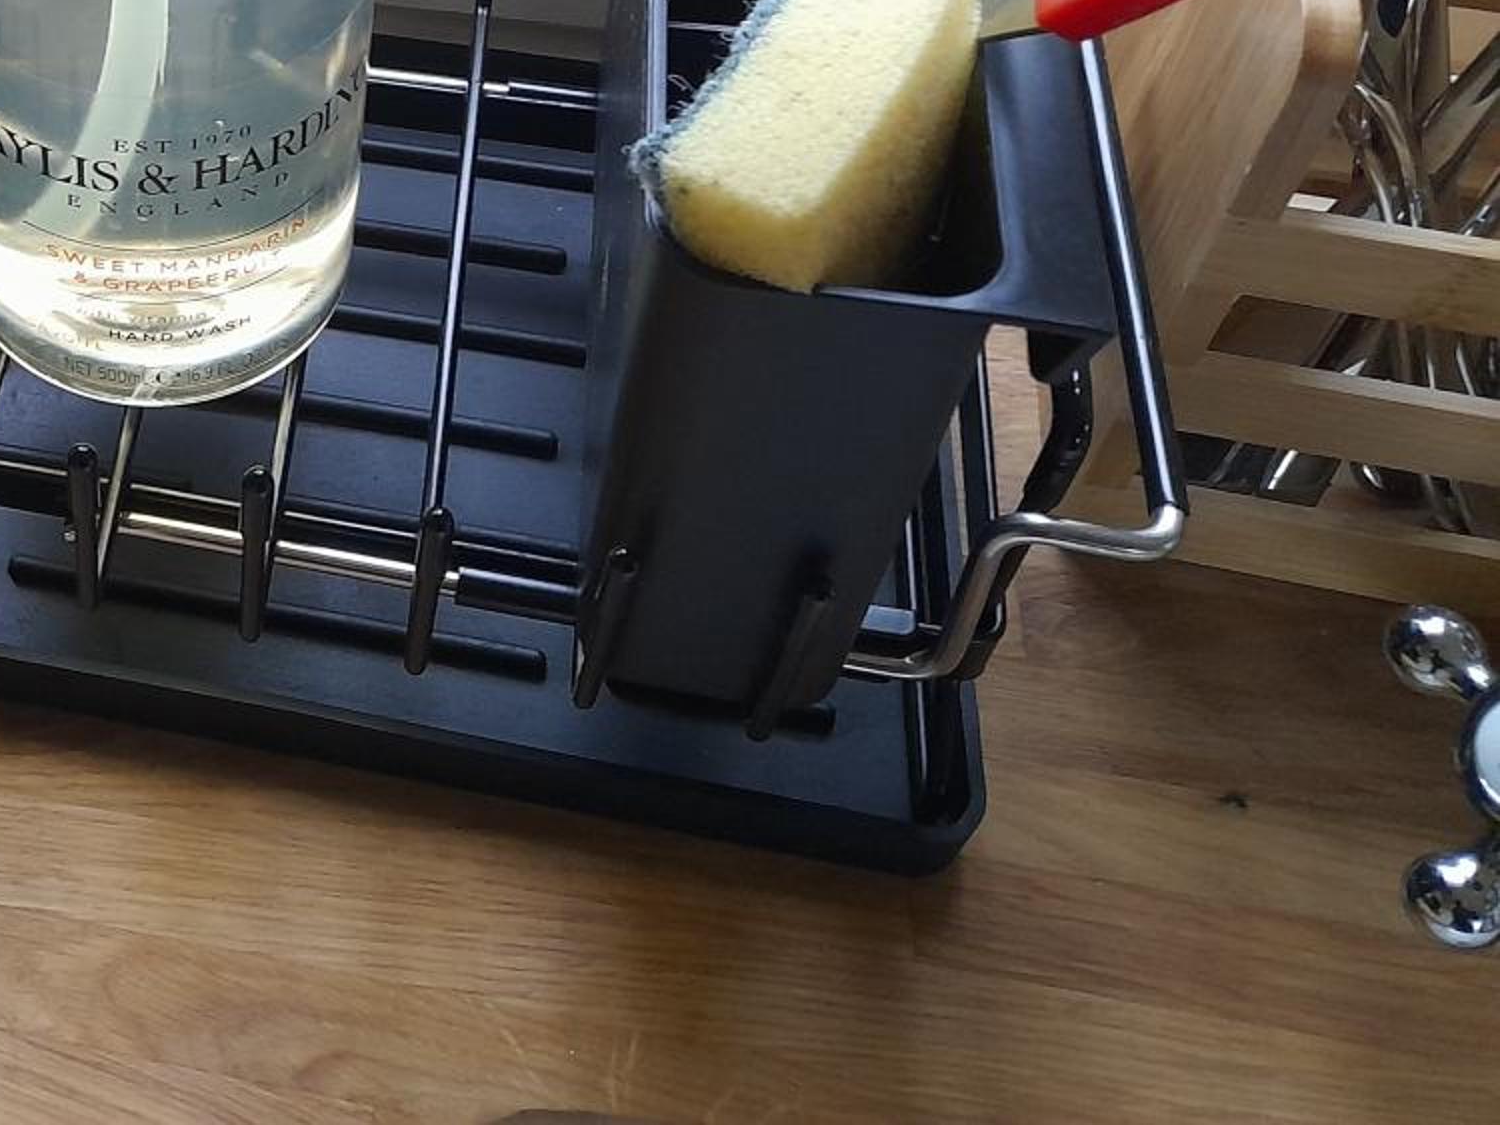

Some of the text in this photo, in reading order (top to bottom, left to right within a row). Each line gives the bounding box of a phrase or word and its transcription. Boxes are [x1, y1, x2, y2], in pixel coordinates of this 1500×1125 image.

[113, 125, 251, 155] EST 1970
[137, 161, 180, 196] &
[67, 172, 289, 218] ENGLAND
[47, 243, 146, 274] SWEET
[108, 328, 174, 343] HAND
[185, 315, 252, 340] WASH
